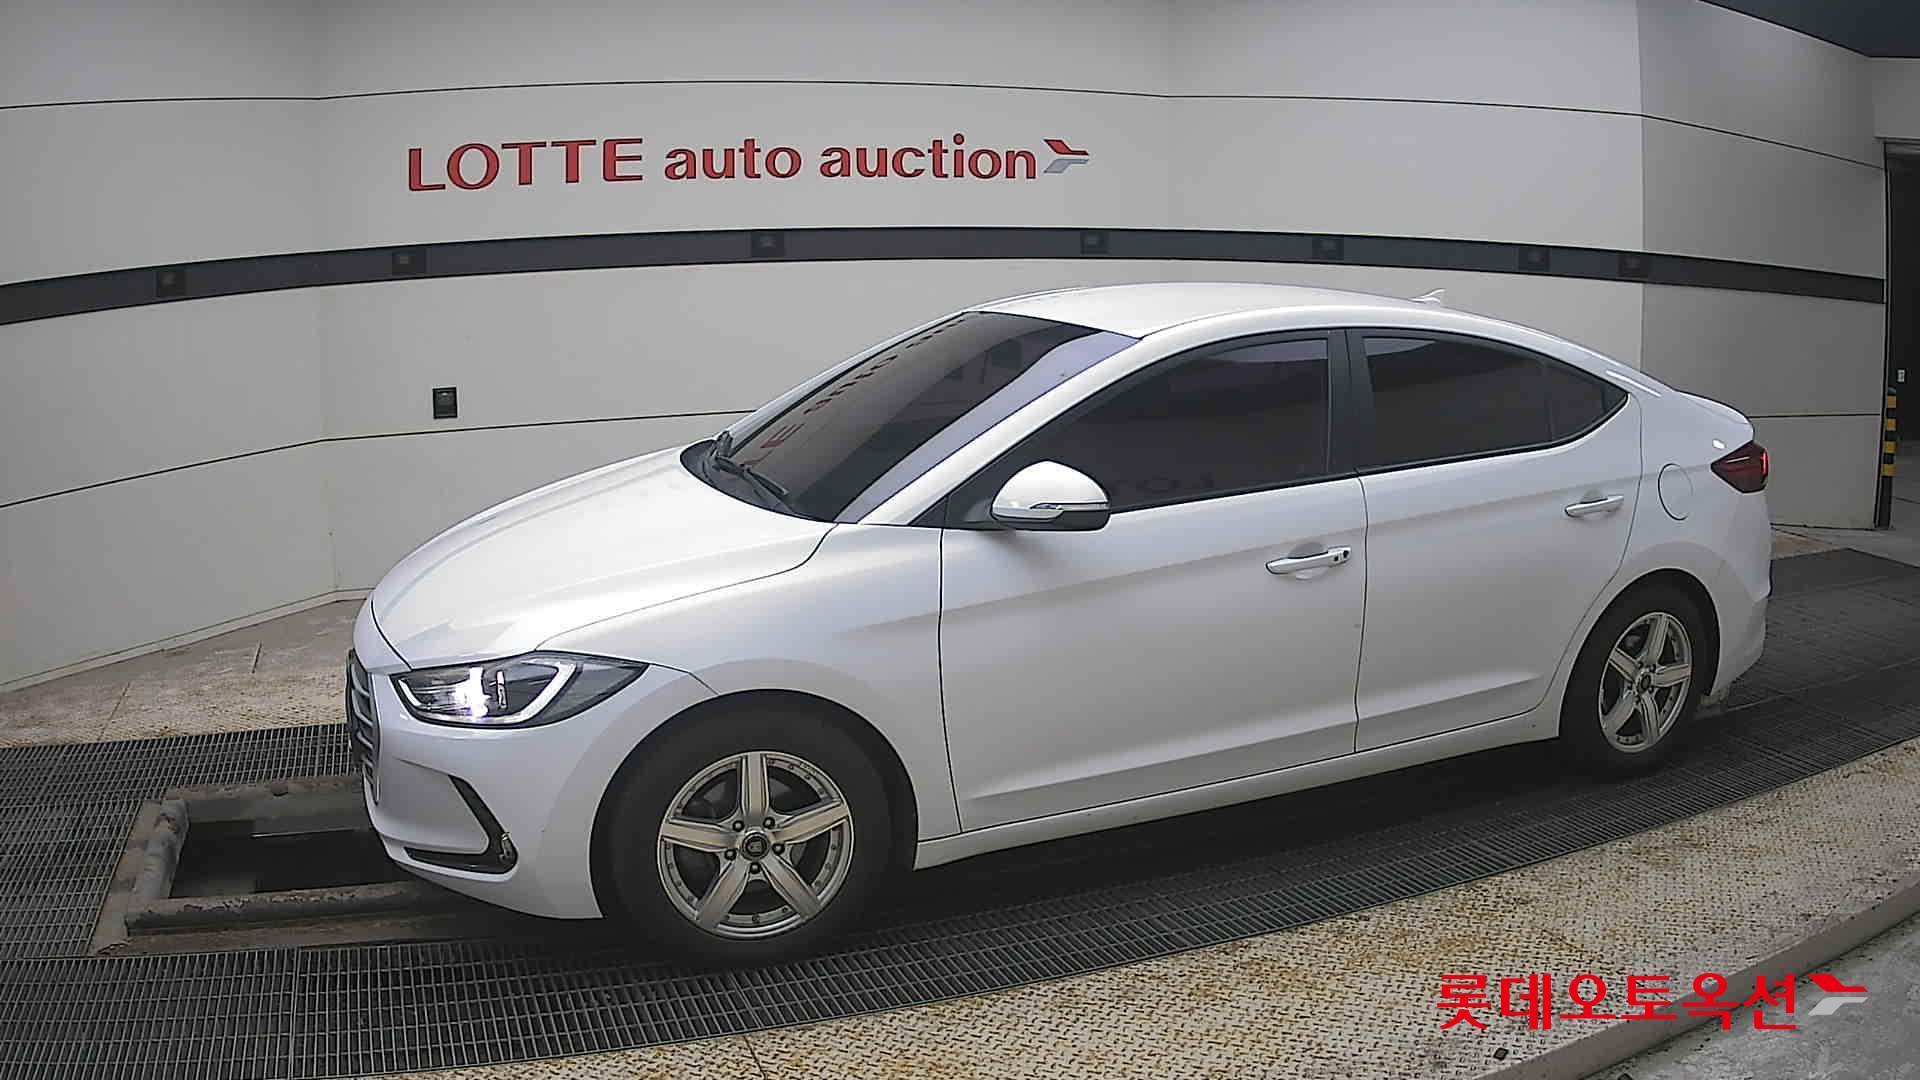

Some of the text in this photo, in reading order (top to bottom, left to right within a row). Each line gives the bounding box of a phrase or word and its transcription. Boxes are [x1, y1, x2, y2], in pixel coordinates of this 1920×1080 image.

[408, 133, 1037, 192] LOTTE auto auction
